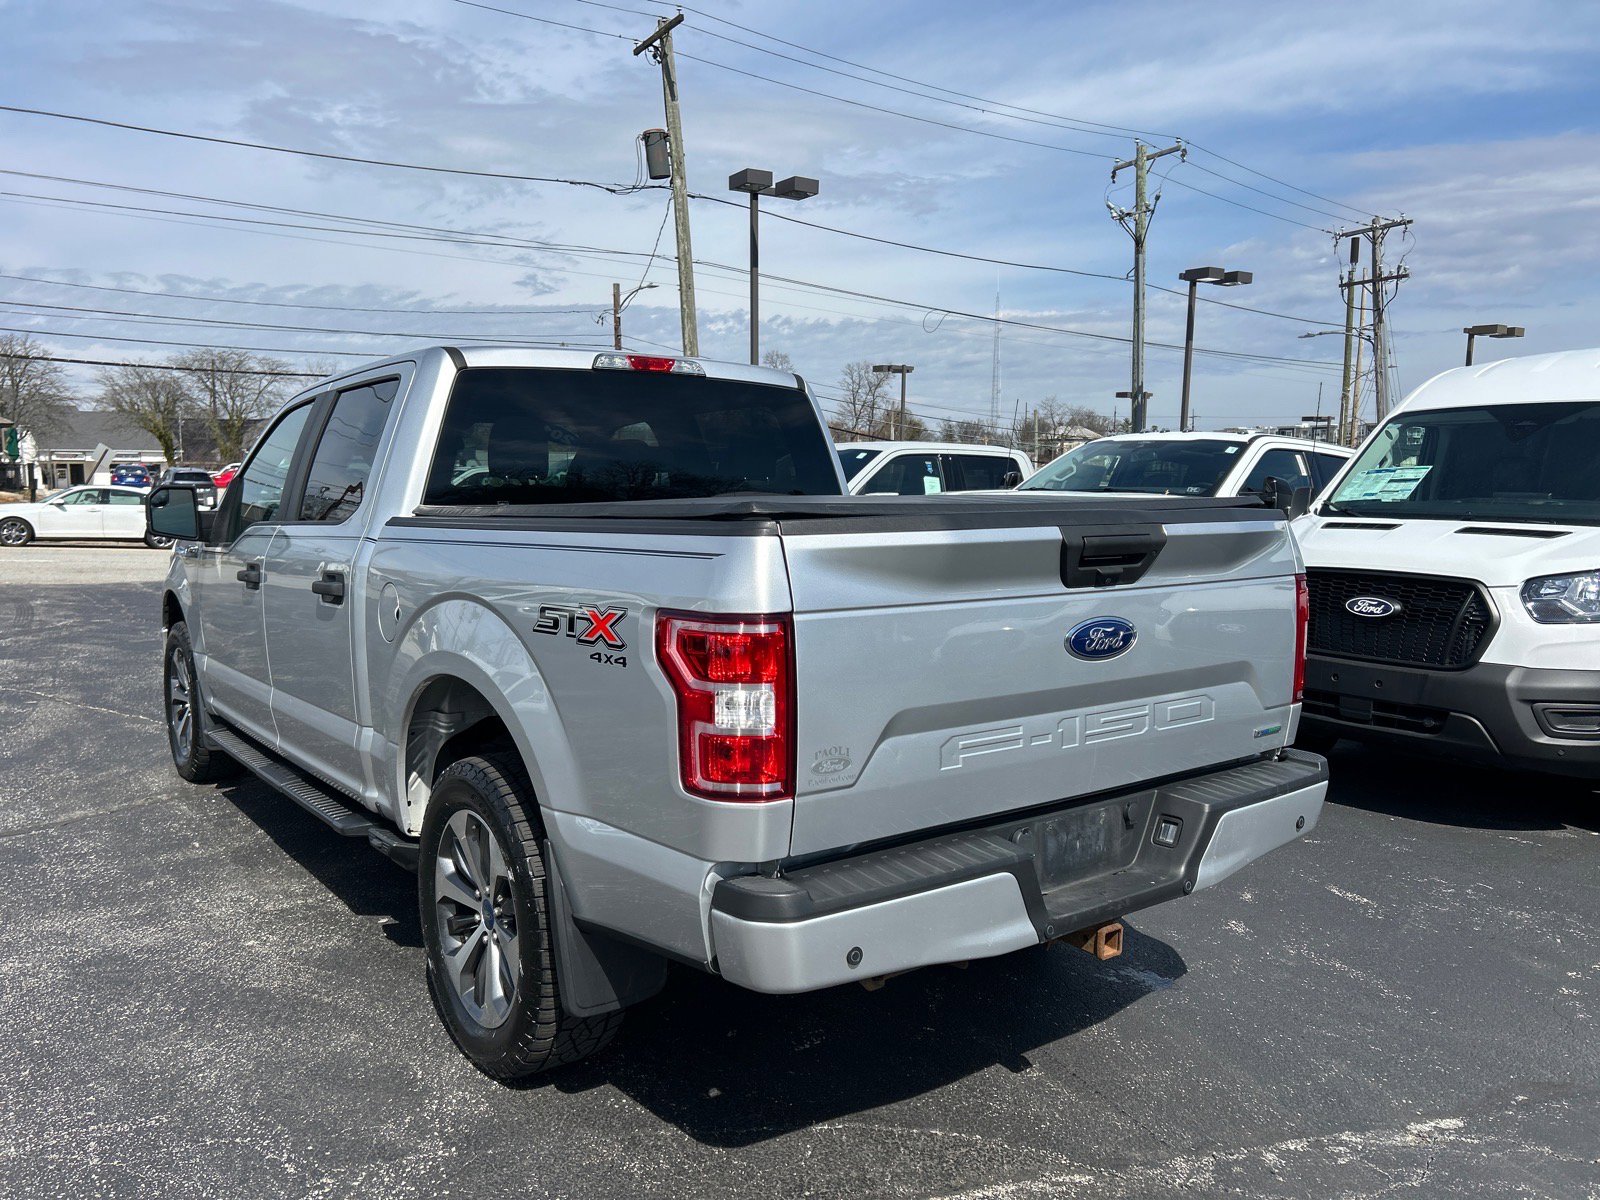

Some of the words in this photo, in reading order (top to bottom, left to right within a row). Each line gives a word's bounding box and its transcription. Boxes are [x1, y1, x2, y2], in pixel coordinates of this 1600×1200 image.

[1354, 600, 1385, 614] Ford
[533, 603, 629, 652] STX
[1085, 627, 1125, 652] Ford
[939, 694, 1215, 771] F-150
[814, 745, 850, 761] PAOLI
